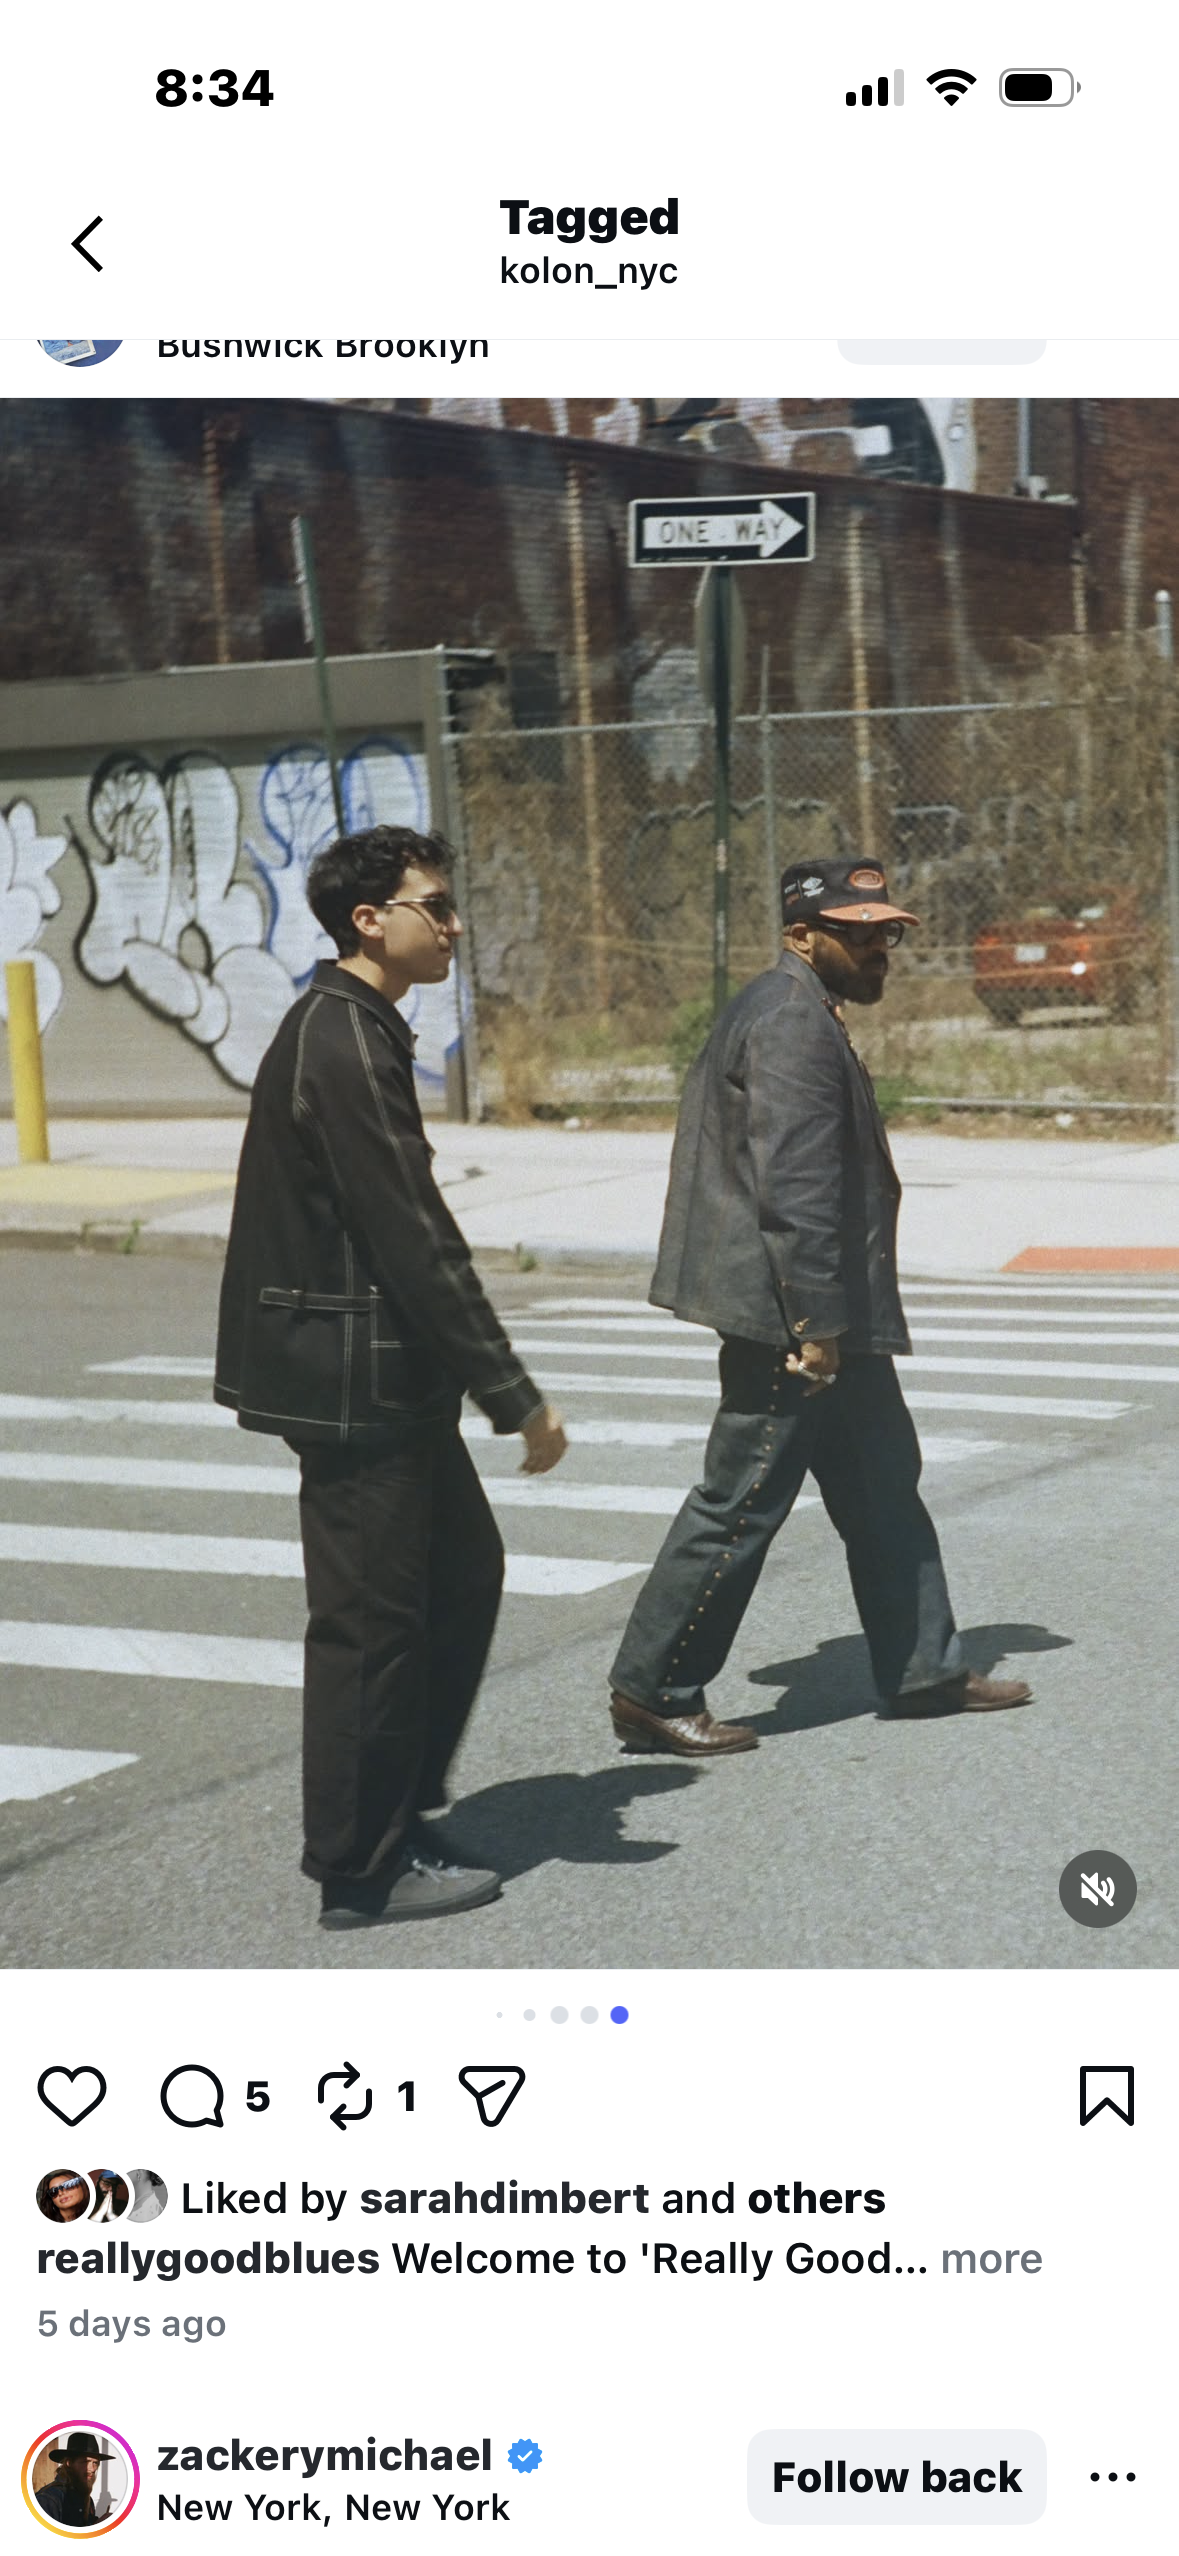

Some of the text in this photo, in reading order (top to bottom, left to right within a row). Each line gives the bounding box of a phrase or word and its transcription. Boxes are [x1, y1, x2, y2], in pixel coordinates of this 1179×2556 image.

[155, 68, 275, 108] 8:34
[499, 197, 679, 245] Tagged
[501, 255, 678, 291] kolon_nyc
[658, 516, 785, 545] ONE WAY
[245, 2080, 271, 2113] 5
[397, 2080, 415, 2112] 1
[182, 2178, 886, 2222] Liked by sarahdimbert and others
[37, 2240, 380, 2282] reallygoodblues
[391, 2241, 575, 2275] Welcome
[586, 2244, 627, 2275] to
[641, 2241, 774, 2282] 'Really
[942, 2249, 1043, 2275] more
[38, 2308, 226, 2344] 5 days ago
[157, 2435, 492, 2479] zackerymichael
[773, 2459, 1024, 2494] Follow back
[158, 2492, 511, 2528] New York, New York
